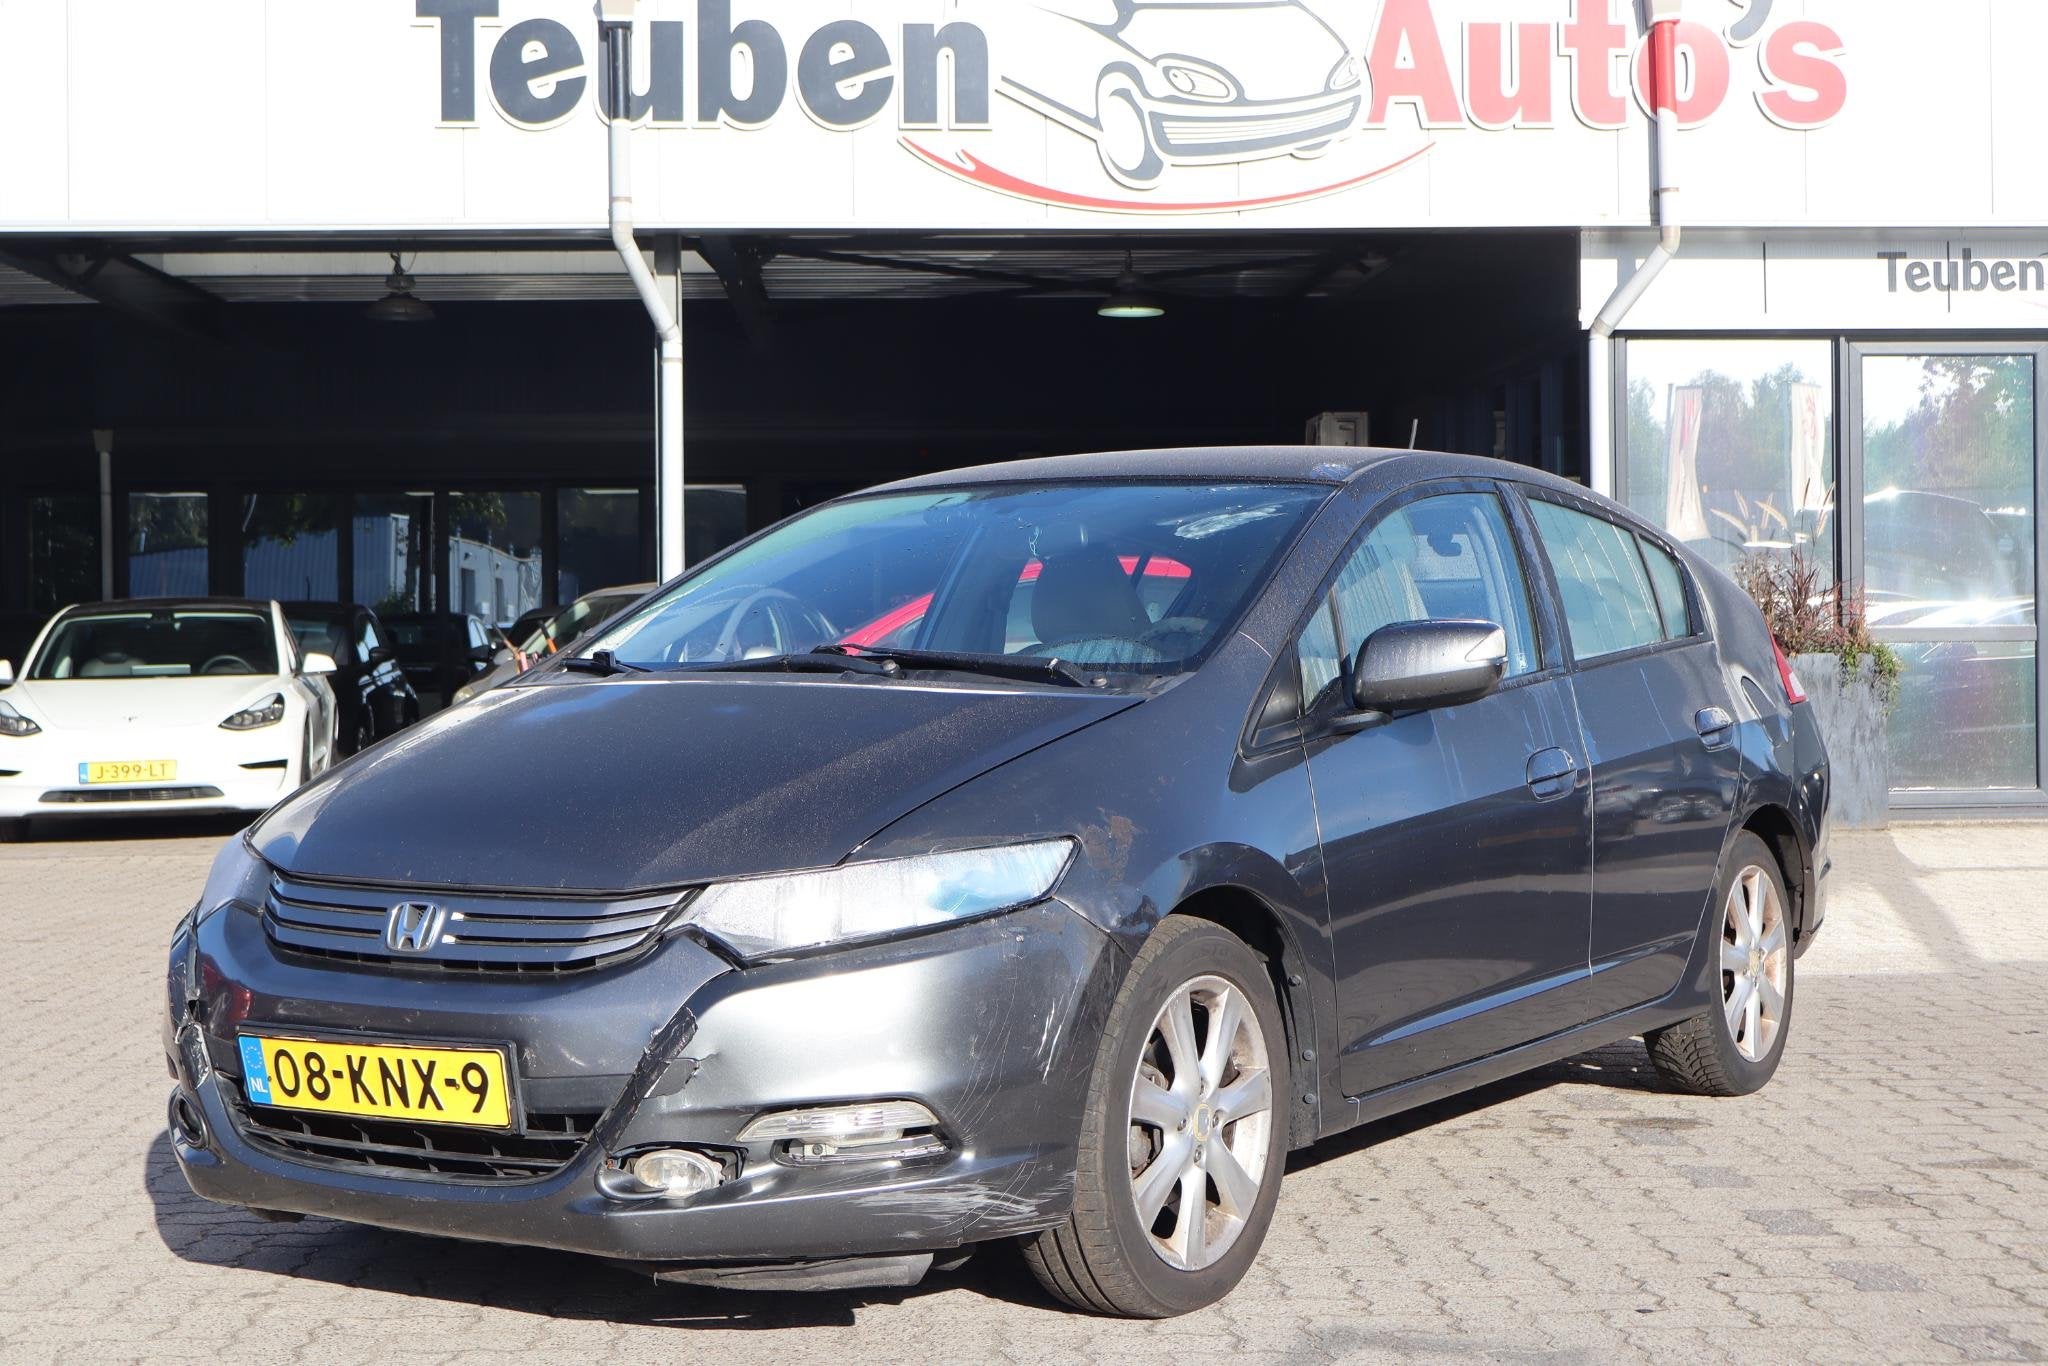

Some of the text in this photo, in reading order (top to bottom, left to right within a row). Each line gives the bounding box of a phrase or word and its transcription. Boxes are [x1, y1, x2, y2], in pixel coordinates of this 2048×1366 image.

[416, 0, 1847, 125] Teuben Auto's
[1877, 248, 2045, 292] Teuben
[97, 763, 168, 779] J-399-LT
[250, 1076, 268, 1093] NL
[274, 1048, 489, 1113] 08-KNX-9
